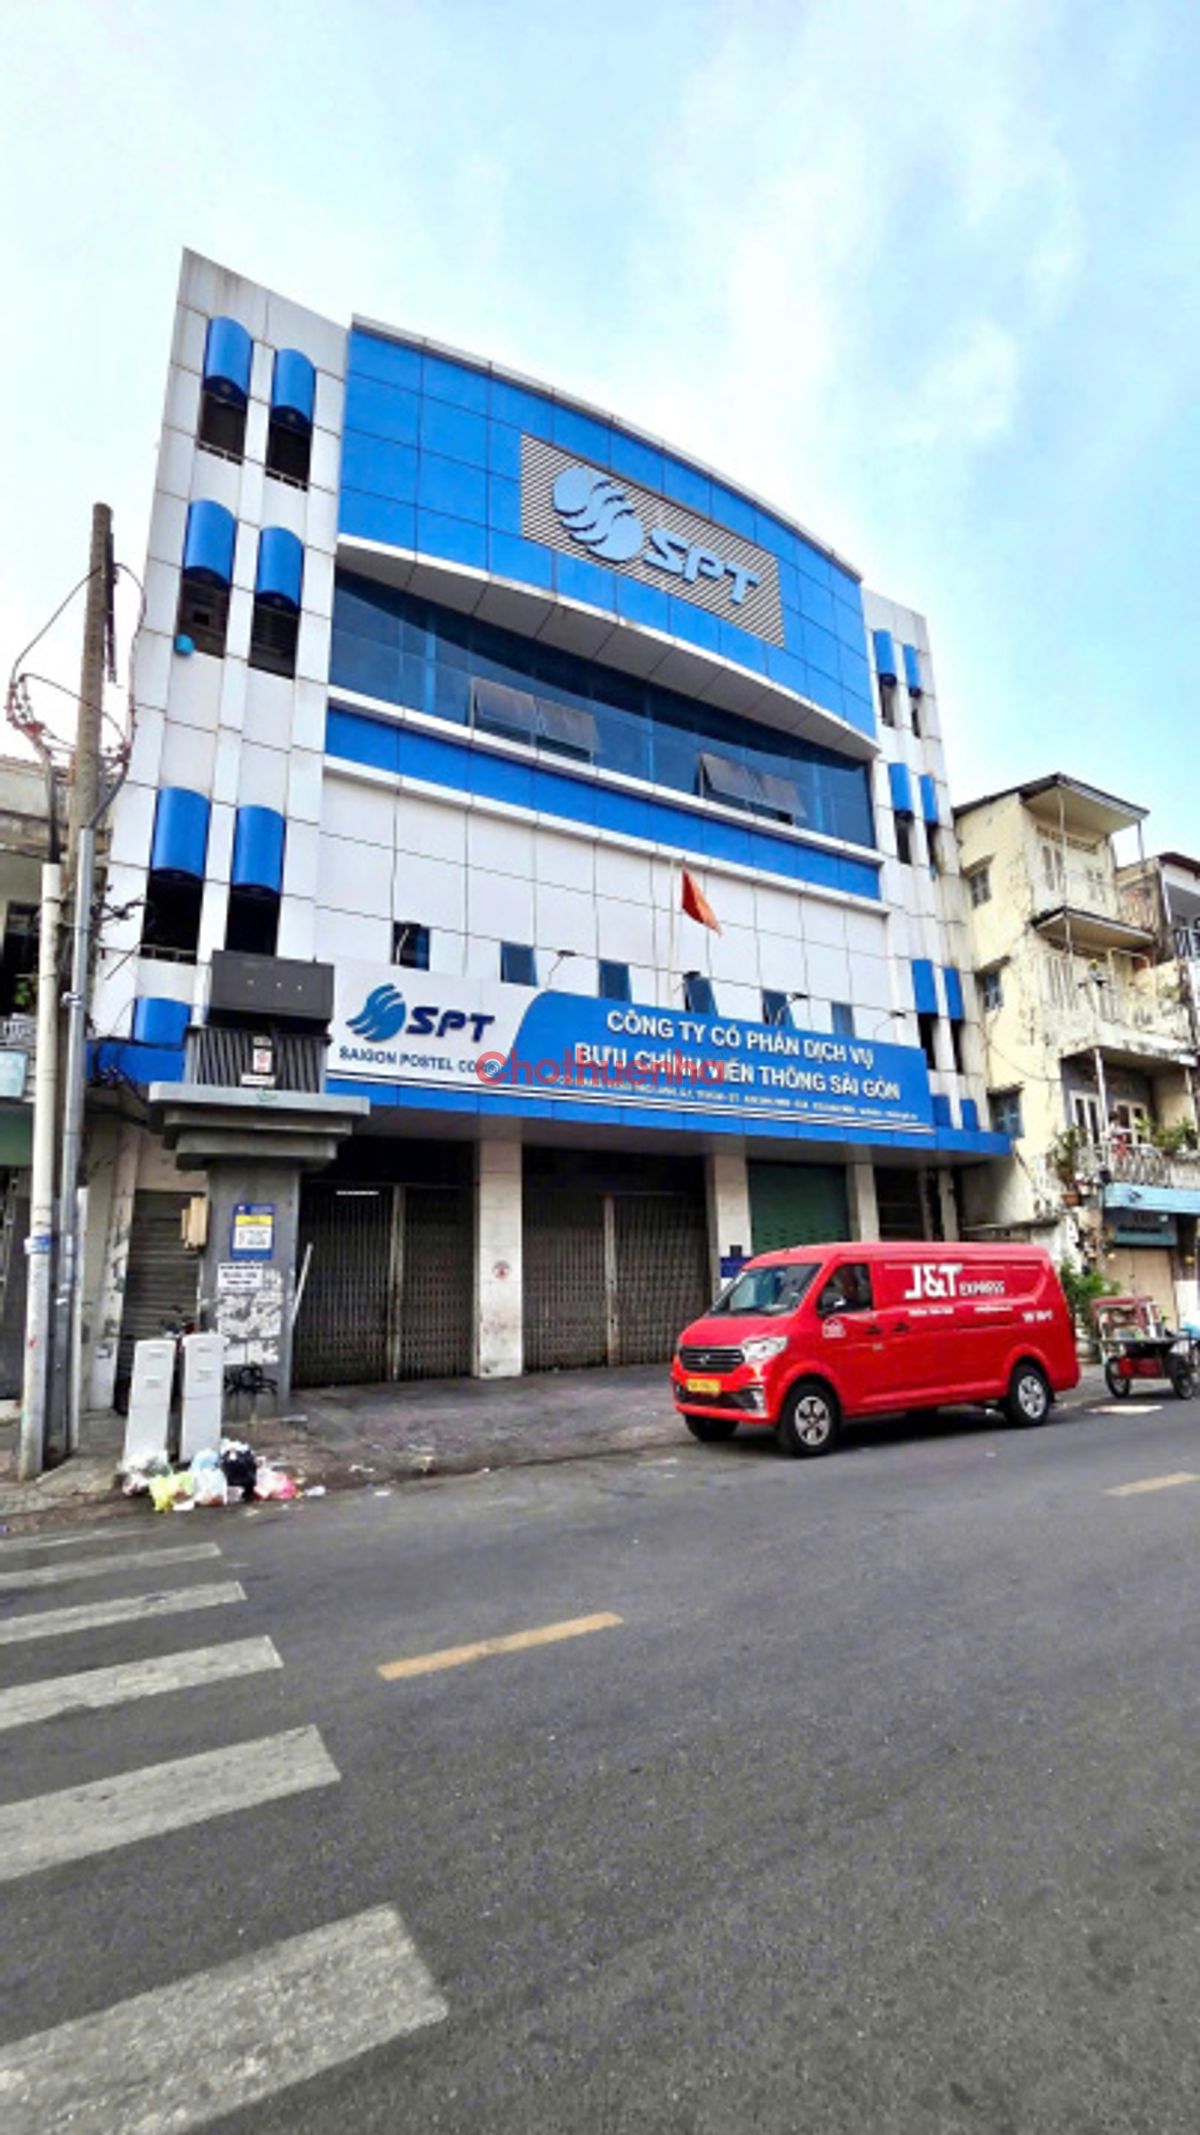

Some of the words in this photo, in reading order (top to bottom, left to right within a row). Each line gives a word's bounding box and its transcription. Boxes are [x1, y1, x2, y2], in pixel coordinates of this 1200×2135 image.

[642, 527, 759, 605] SPT
[405, 1006, 495, 1042] SPT
[607, 1009, 674, 1039] CÔNG
[679, 1021, 706, 1043] TY
[803, 1039, 847, 1064] DỊCH
[851, 1047, 874, 1070] VỤ
[339, 1046, 397, 1065] SAIGON
[400, 1054, 453, 1071] POSTEL
[758, 1065, 826, 1092] THÔNG
[905, 1263, 963, 1299] J&T
